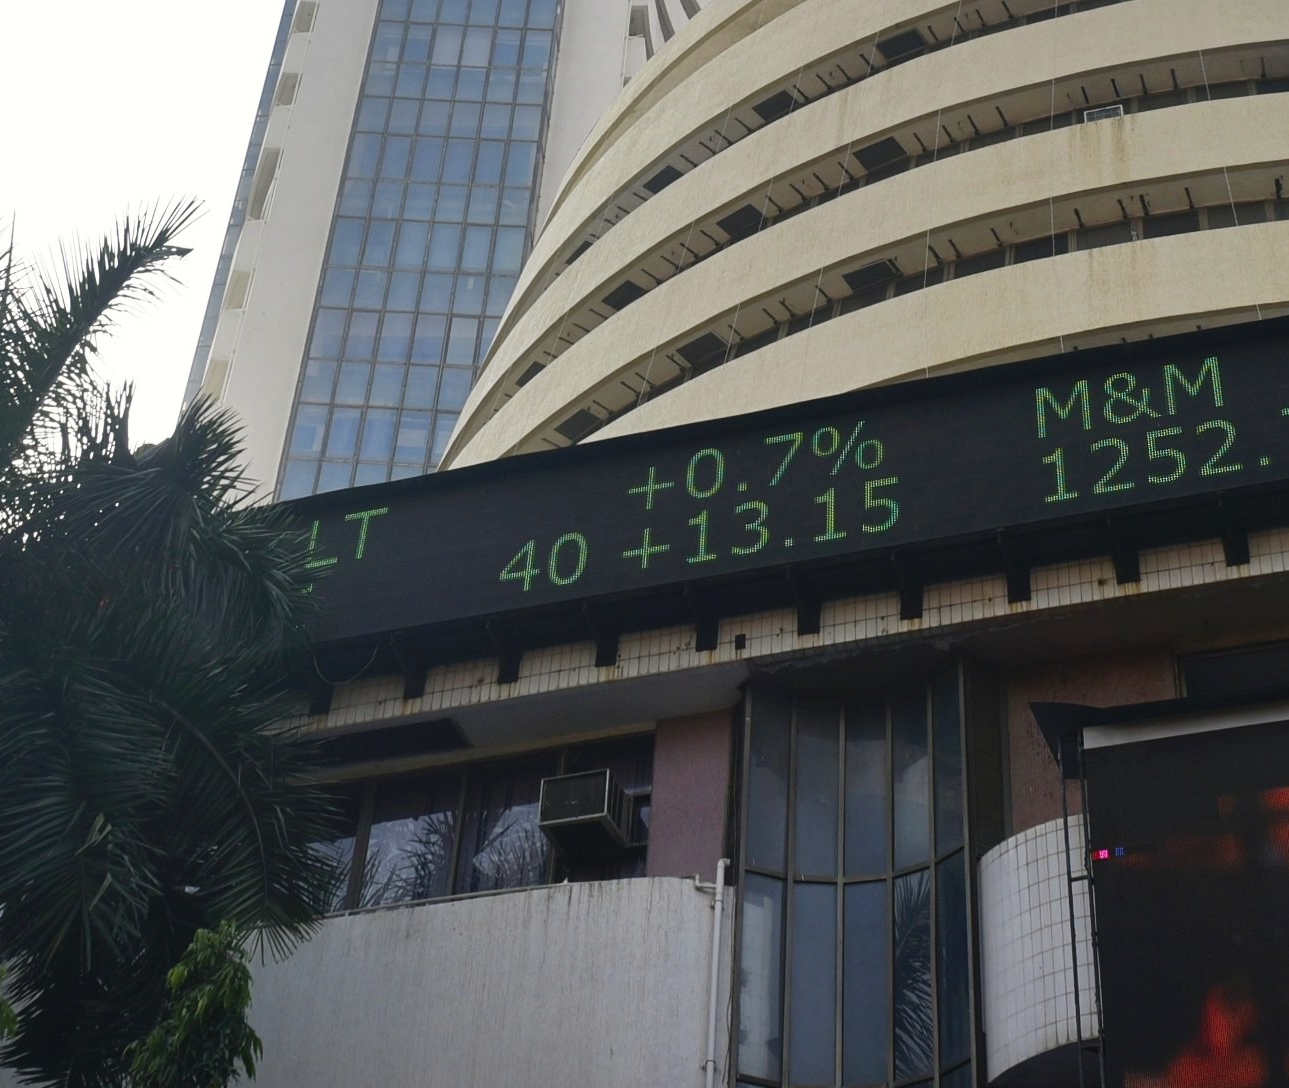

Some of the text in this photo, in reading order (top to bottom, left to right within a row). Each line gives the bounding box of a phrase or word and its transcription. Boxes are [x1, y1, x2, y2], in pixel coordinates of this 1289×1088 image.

[1036, 357, 1224, 438] M&M
[629, 420, 884, 509] +0.7%
[499, 476, 900, 591] 40 +13.15
